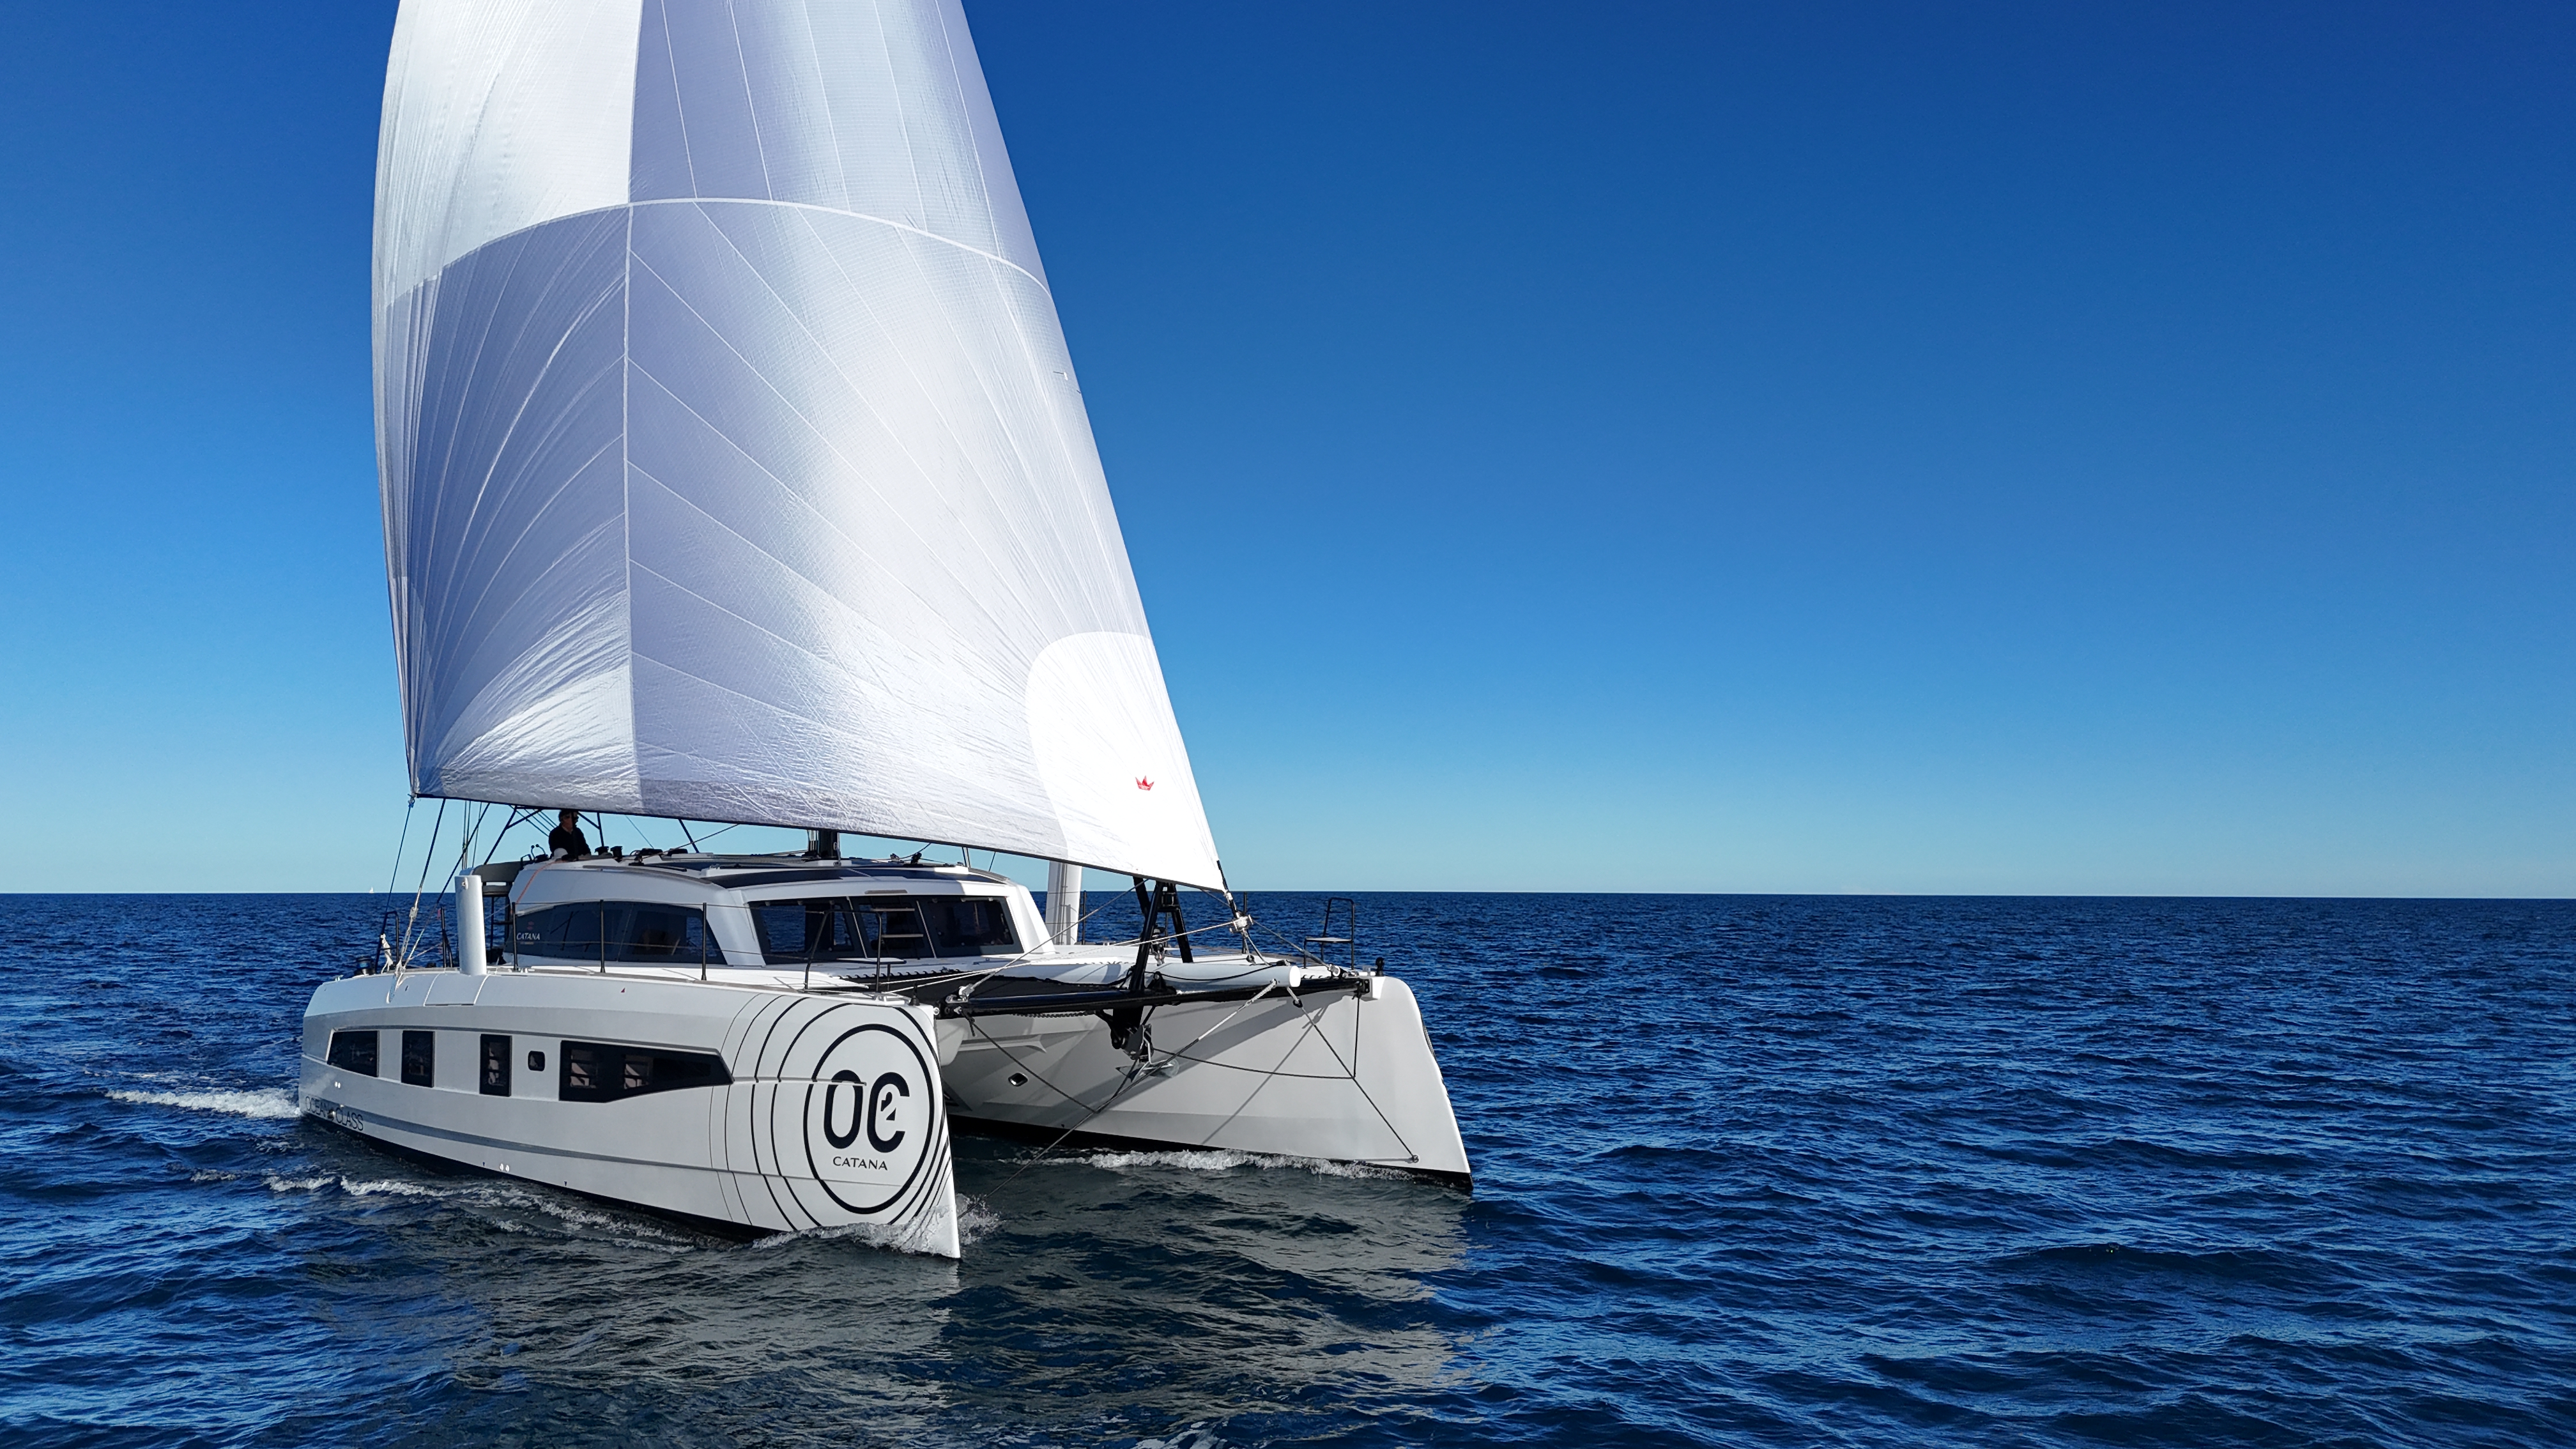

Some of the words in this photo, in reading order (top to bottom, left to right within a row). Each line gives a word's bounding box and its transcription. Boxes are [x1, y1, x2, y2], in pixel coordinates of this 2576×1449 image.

[516, 932, 540, 940] CATANA
[335, 1107, 364, 1131] CLASS
[832, 1156, 888, 1171] CATANA
